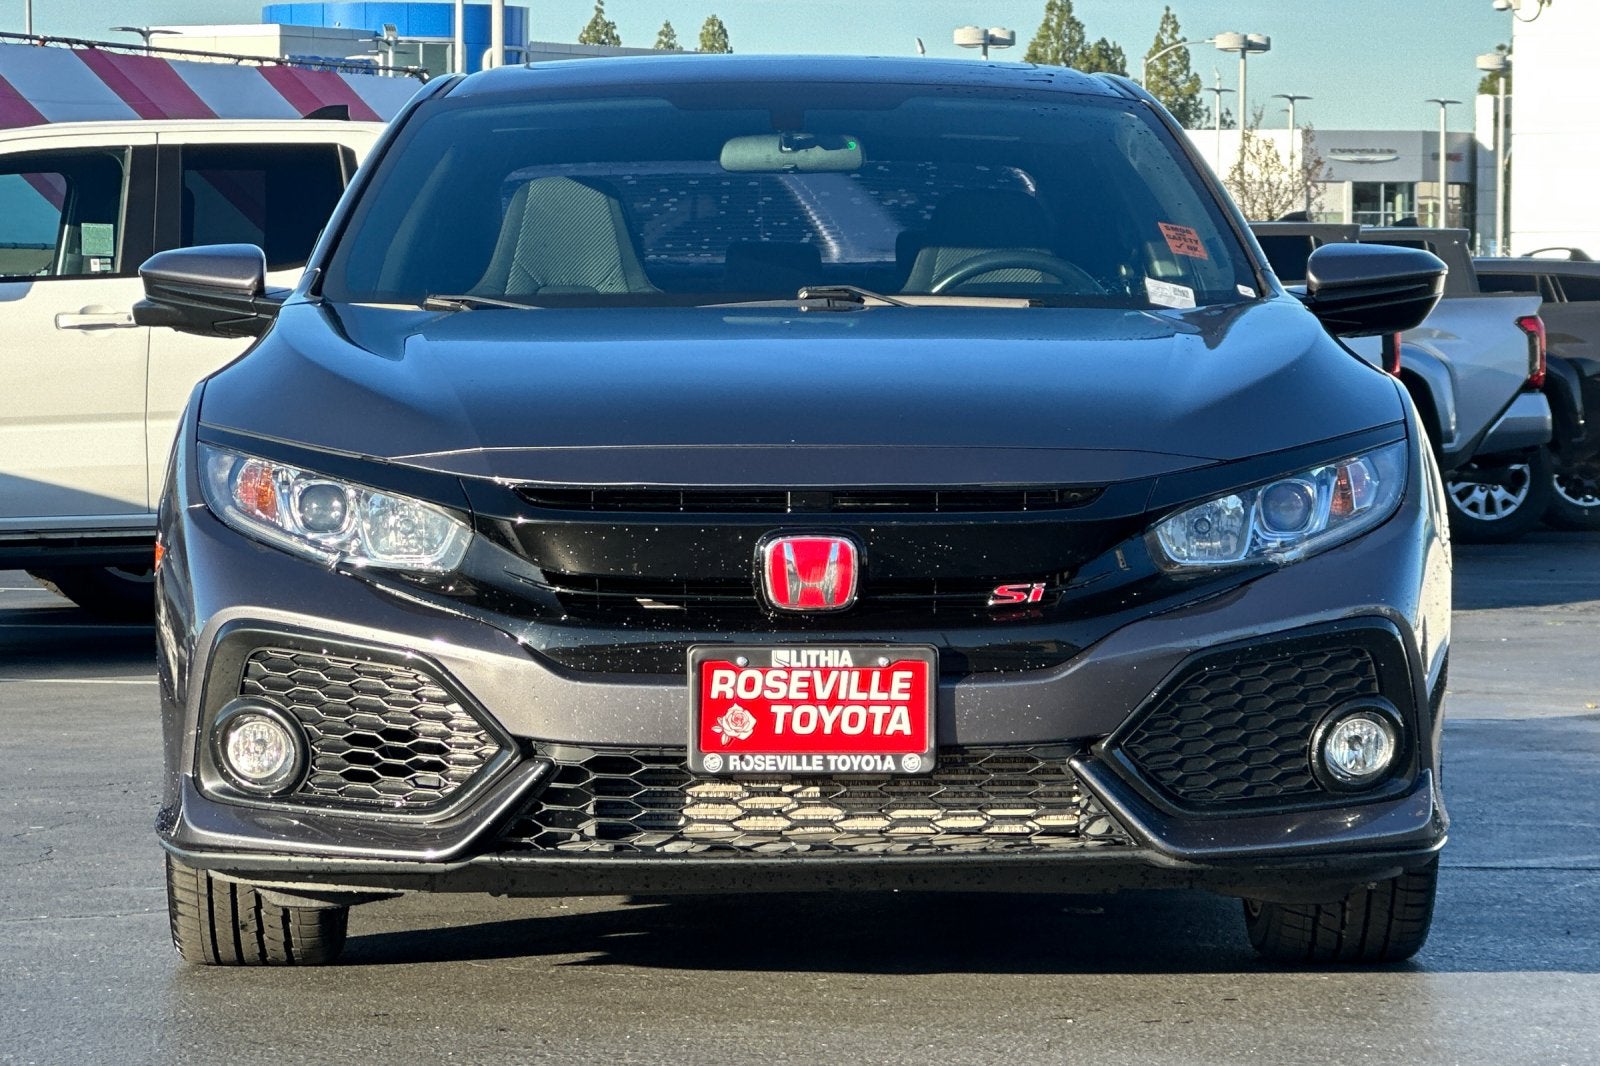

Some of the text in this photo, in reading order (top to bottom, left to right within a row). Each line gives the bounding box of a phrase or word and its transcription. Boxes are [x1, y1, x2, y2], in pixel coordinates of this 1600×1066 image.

[1166, 234, 1199, 245] SAFETY
[790, 649, 854, 668] LITHIA
[710, 669, 913, 701] ROSEVILLE
[770, 704, 912, 736] TOYOTA
[729, 754, 824, 771] ROSEVILLE
[827, 754, 896, 771] TOYOTA
